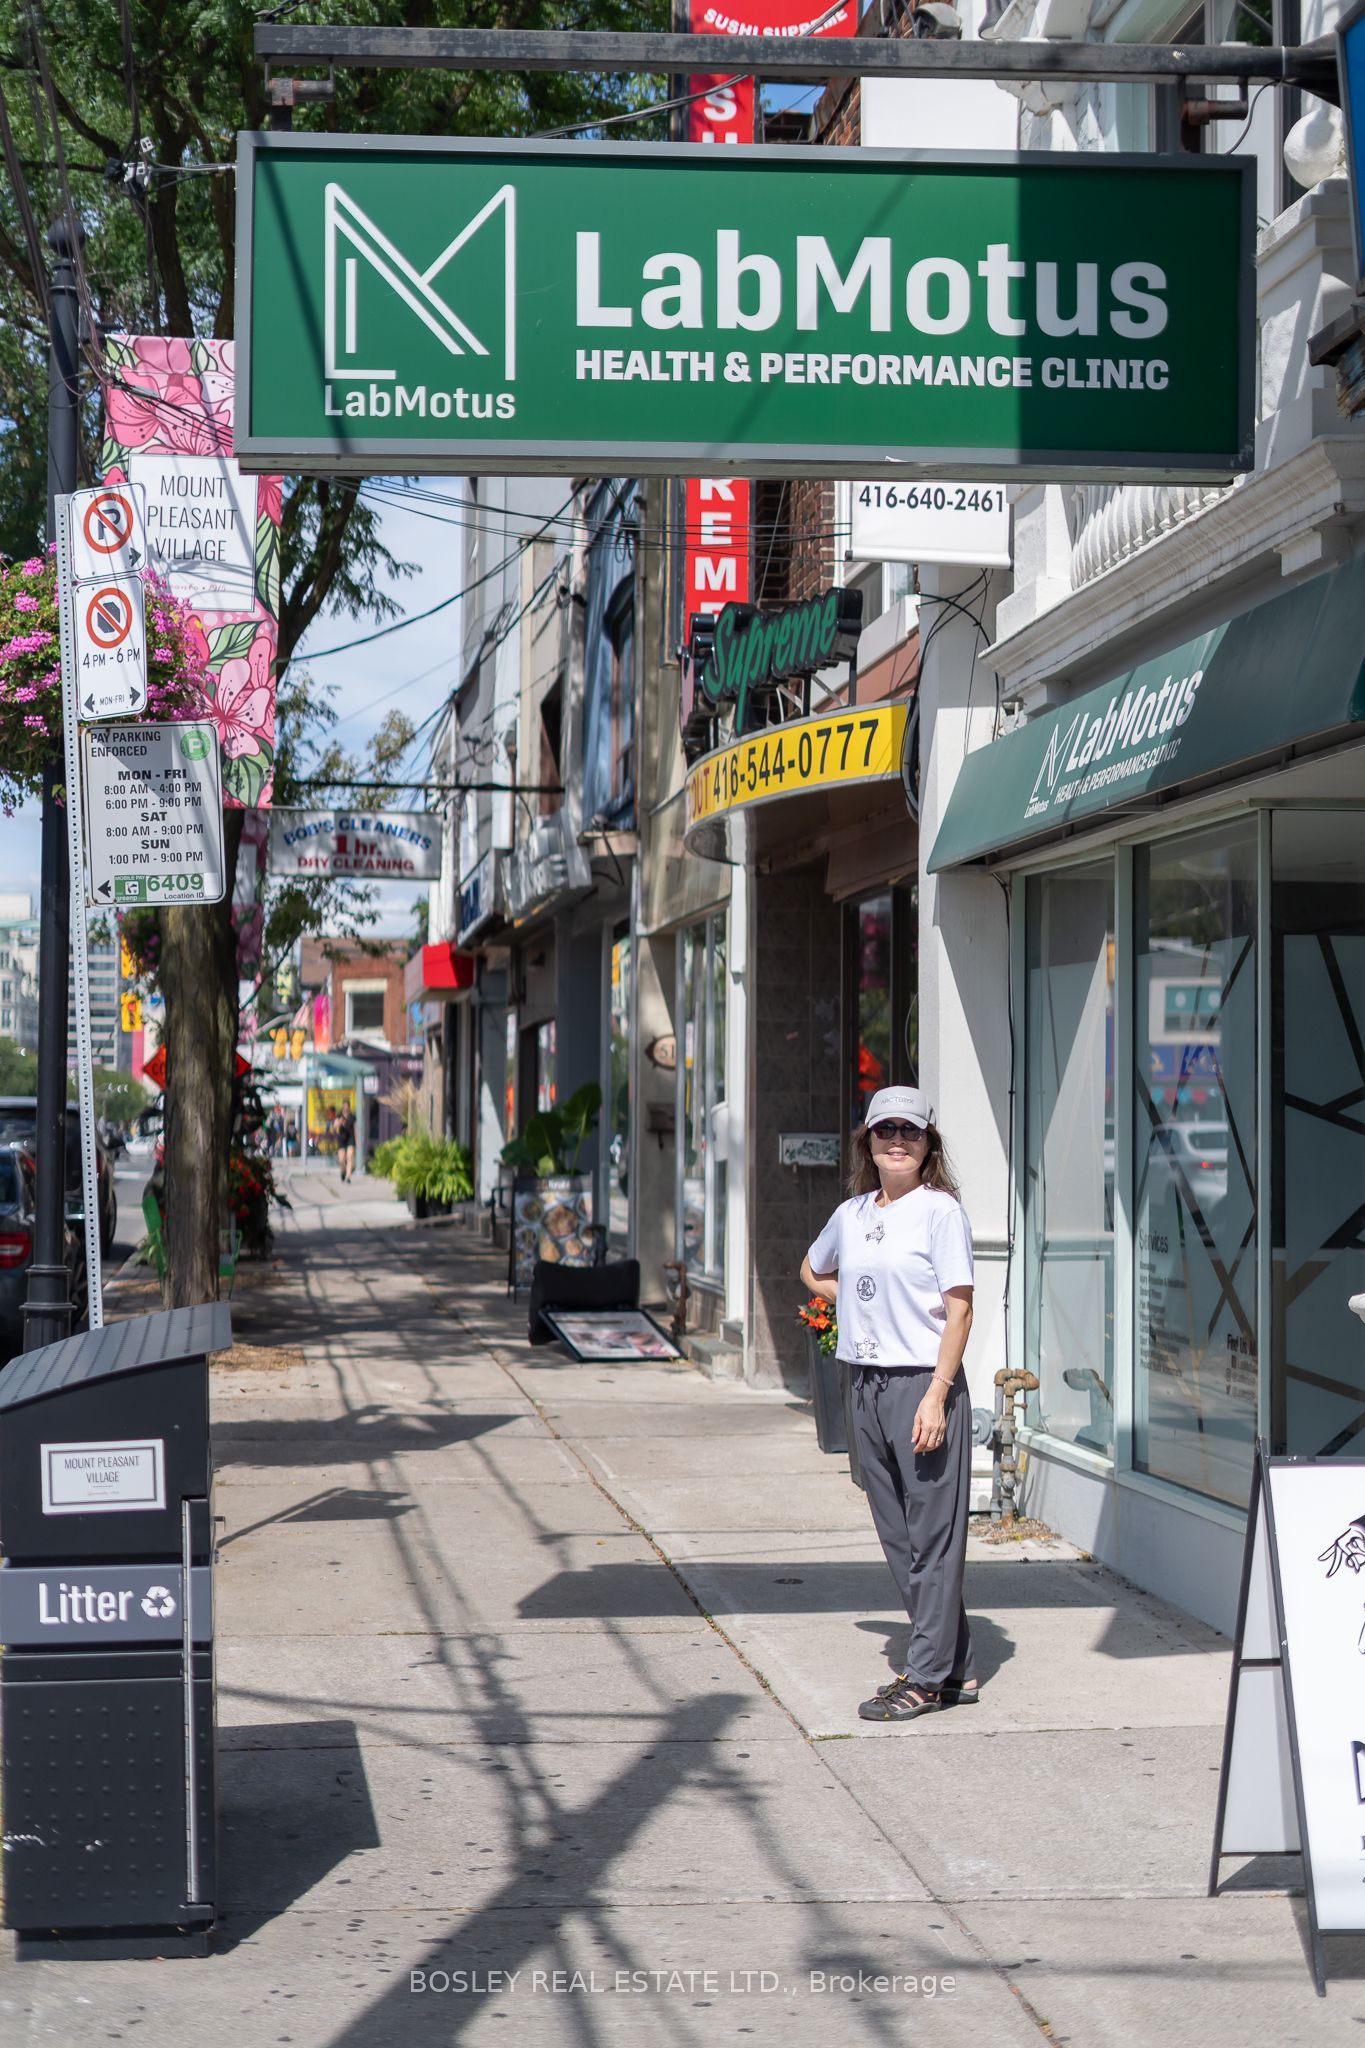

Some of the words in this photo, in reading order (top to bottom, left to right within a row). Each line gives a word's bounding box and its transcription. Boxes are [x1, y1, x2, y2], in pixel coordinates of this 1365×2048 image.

[704, 8, 759, 36] SUSHI
[577, 229, 1169, 339] LabMotus
[577, 350, 715, 382] HEALTH
[723, 351, 751, 382] &
[761, 352, 1032, 387] PERFORMANCE
[1041, 357, 1169, 390] CLINIC
[325, 384, 516, 419] LabMotus
[160, 475, 227, 498] MOUNT
[859, 485, 1004, 513] 416-640-2461
[147, 506, 237, 530] PLEASANT
[155, 538, 227, 561] VILLAGE
[83, 653, 91, 669] 4
[93, 653, 106, 667] PM
[117, 648, 124, 664] 6
[127, 647, 140, 661] PM
[705, 595, 837, 732] Supreme
[100, 694, 125, 706] MON-FRI
[1065, 670, 1203, 773] LabMotus
[90, 732, 112, 744] PAY
[113, 731, 161, 742] PARKING
[91, 746, 147, 758] ENFORCED
[714, 719, 879, 803] 416-544-0777
[118, 770, 151, 781] MON
[164, 769, 187, 779] FRI
[1054, 778, 1084, 805] HEALTH
[1088, 751, 1150, 791] PERFORMANCE
[1147, 738, 1181, 769] CLINIC
[104, 785, 126, 795] 8:00
[130, 784, 148, 794] AM
[159, 783, 181, 793] 4:00
[184, 782, 202, 792] PM
[105, 799, 127, 809] 6:00
[131, 799, 148, 808] PM
[159, 798, 181, 807] 9:00
[184, 797, 202, 806] PM
[140, 812, 168, 821] SAT
[106, 827, 128, 837] 8:00
[132, 826, 150, 836] AM
[161, 825, 183, 835] 9:00
[186, 824, 204, 834] PM
[283, 819, 335, 846] BOB'S
[339, 818, 432, 849] CLEANERS
[141, 839, 170, 849] SUN
[332, 834, 349, 855] 1
[355, 837, 382, 856] hr.
[109, 855, 129, 864] 1:00
[132, 854, 150, 863] PM
[160, 853, 182, 862] 9:00
[186, 851, 203, 861] PM
[297, 857, 329, 868] DRY
[333, 857, 415, 871] CLEANING
[147, 874, 204, 892] 6409
[64, 1457, 95, 1469] MOUNT
[98, 1455, 139, 1468] PLEASANT
[86, 1471, 119, 1483] VILLAGE
[39, 1583, 134, 1624] Litter
